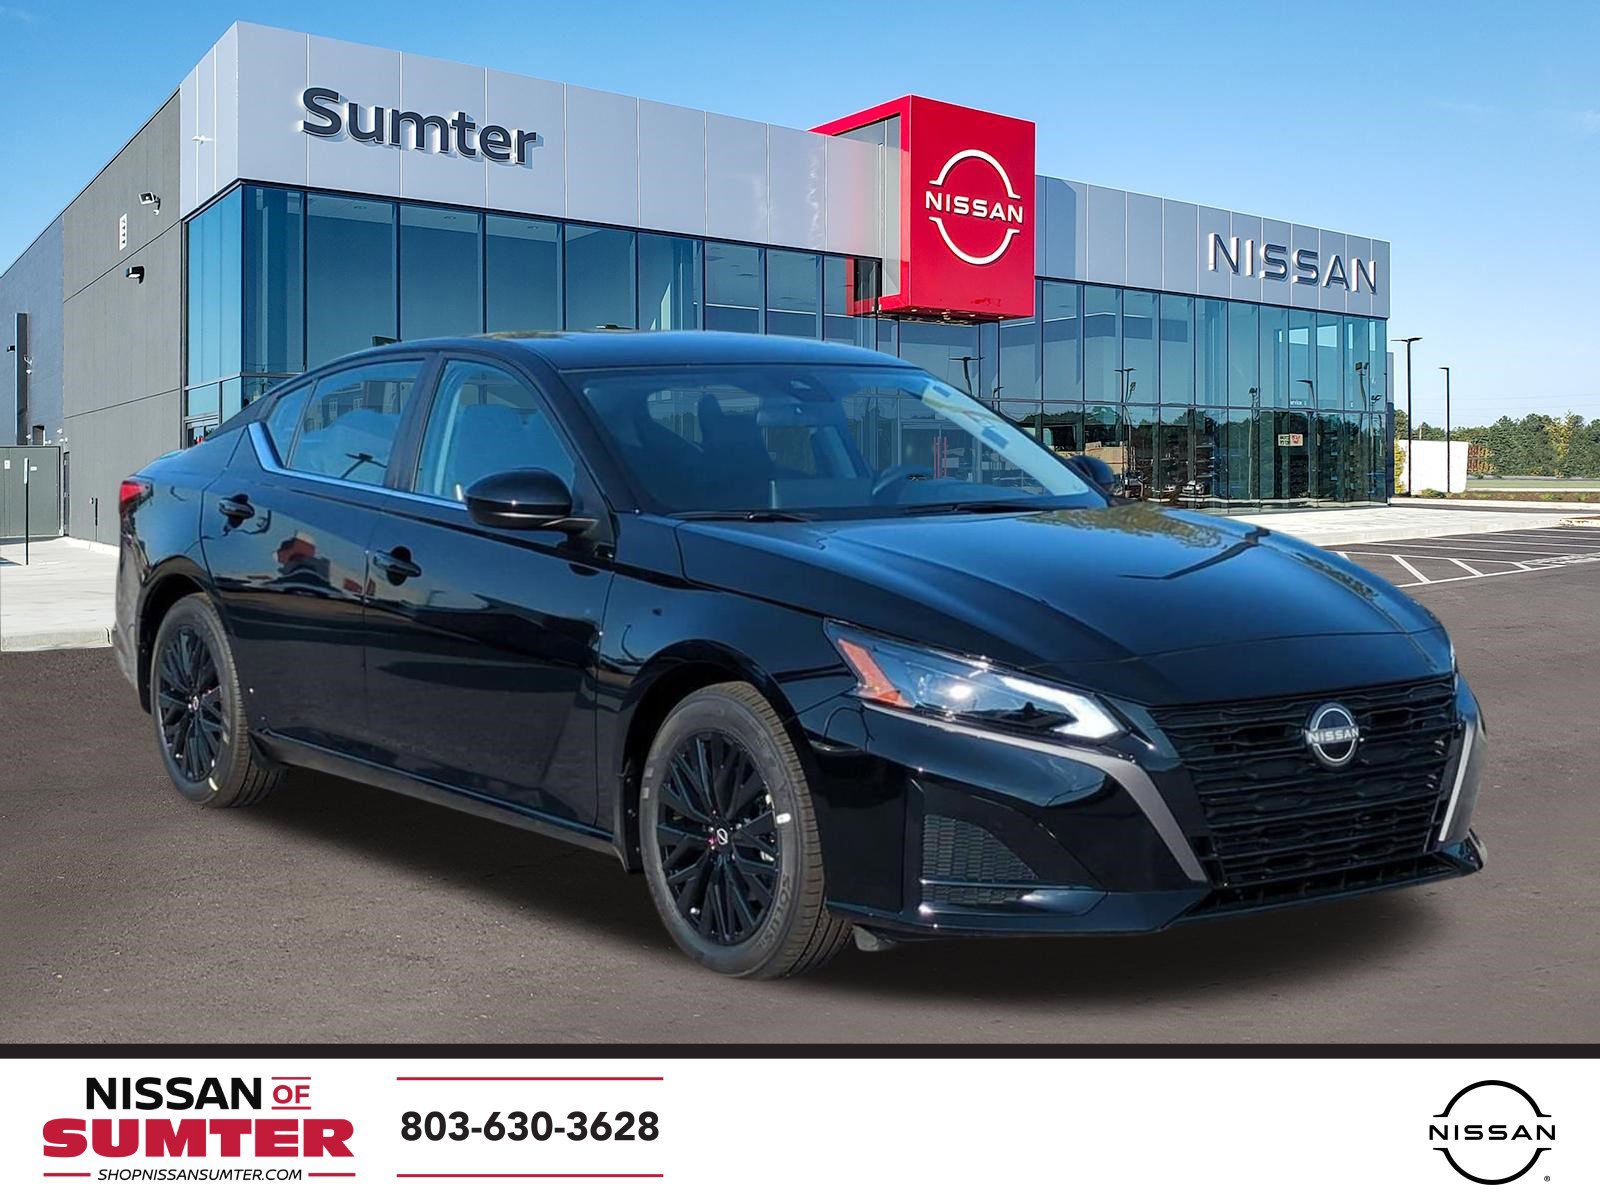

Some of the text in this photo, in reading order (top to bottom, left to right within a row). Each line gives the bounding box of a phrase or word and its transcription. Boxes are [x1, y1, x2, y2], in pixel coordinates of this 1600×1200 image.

[302, 87, 537, 165] Sumter
[925, 190, 1023, 224] NISSAN
[1208, 232, 1377, 295] NISSAN
[1307, 727, 1359, 743] NISSAN
